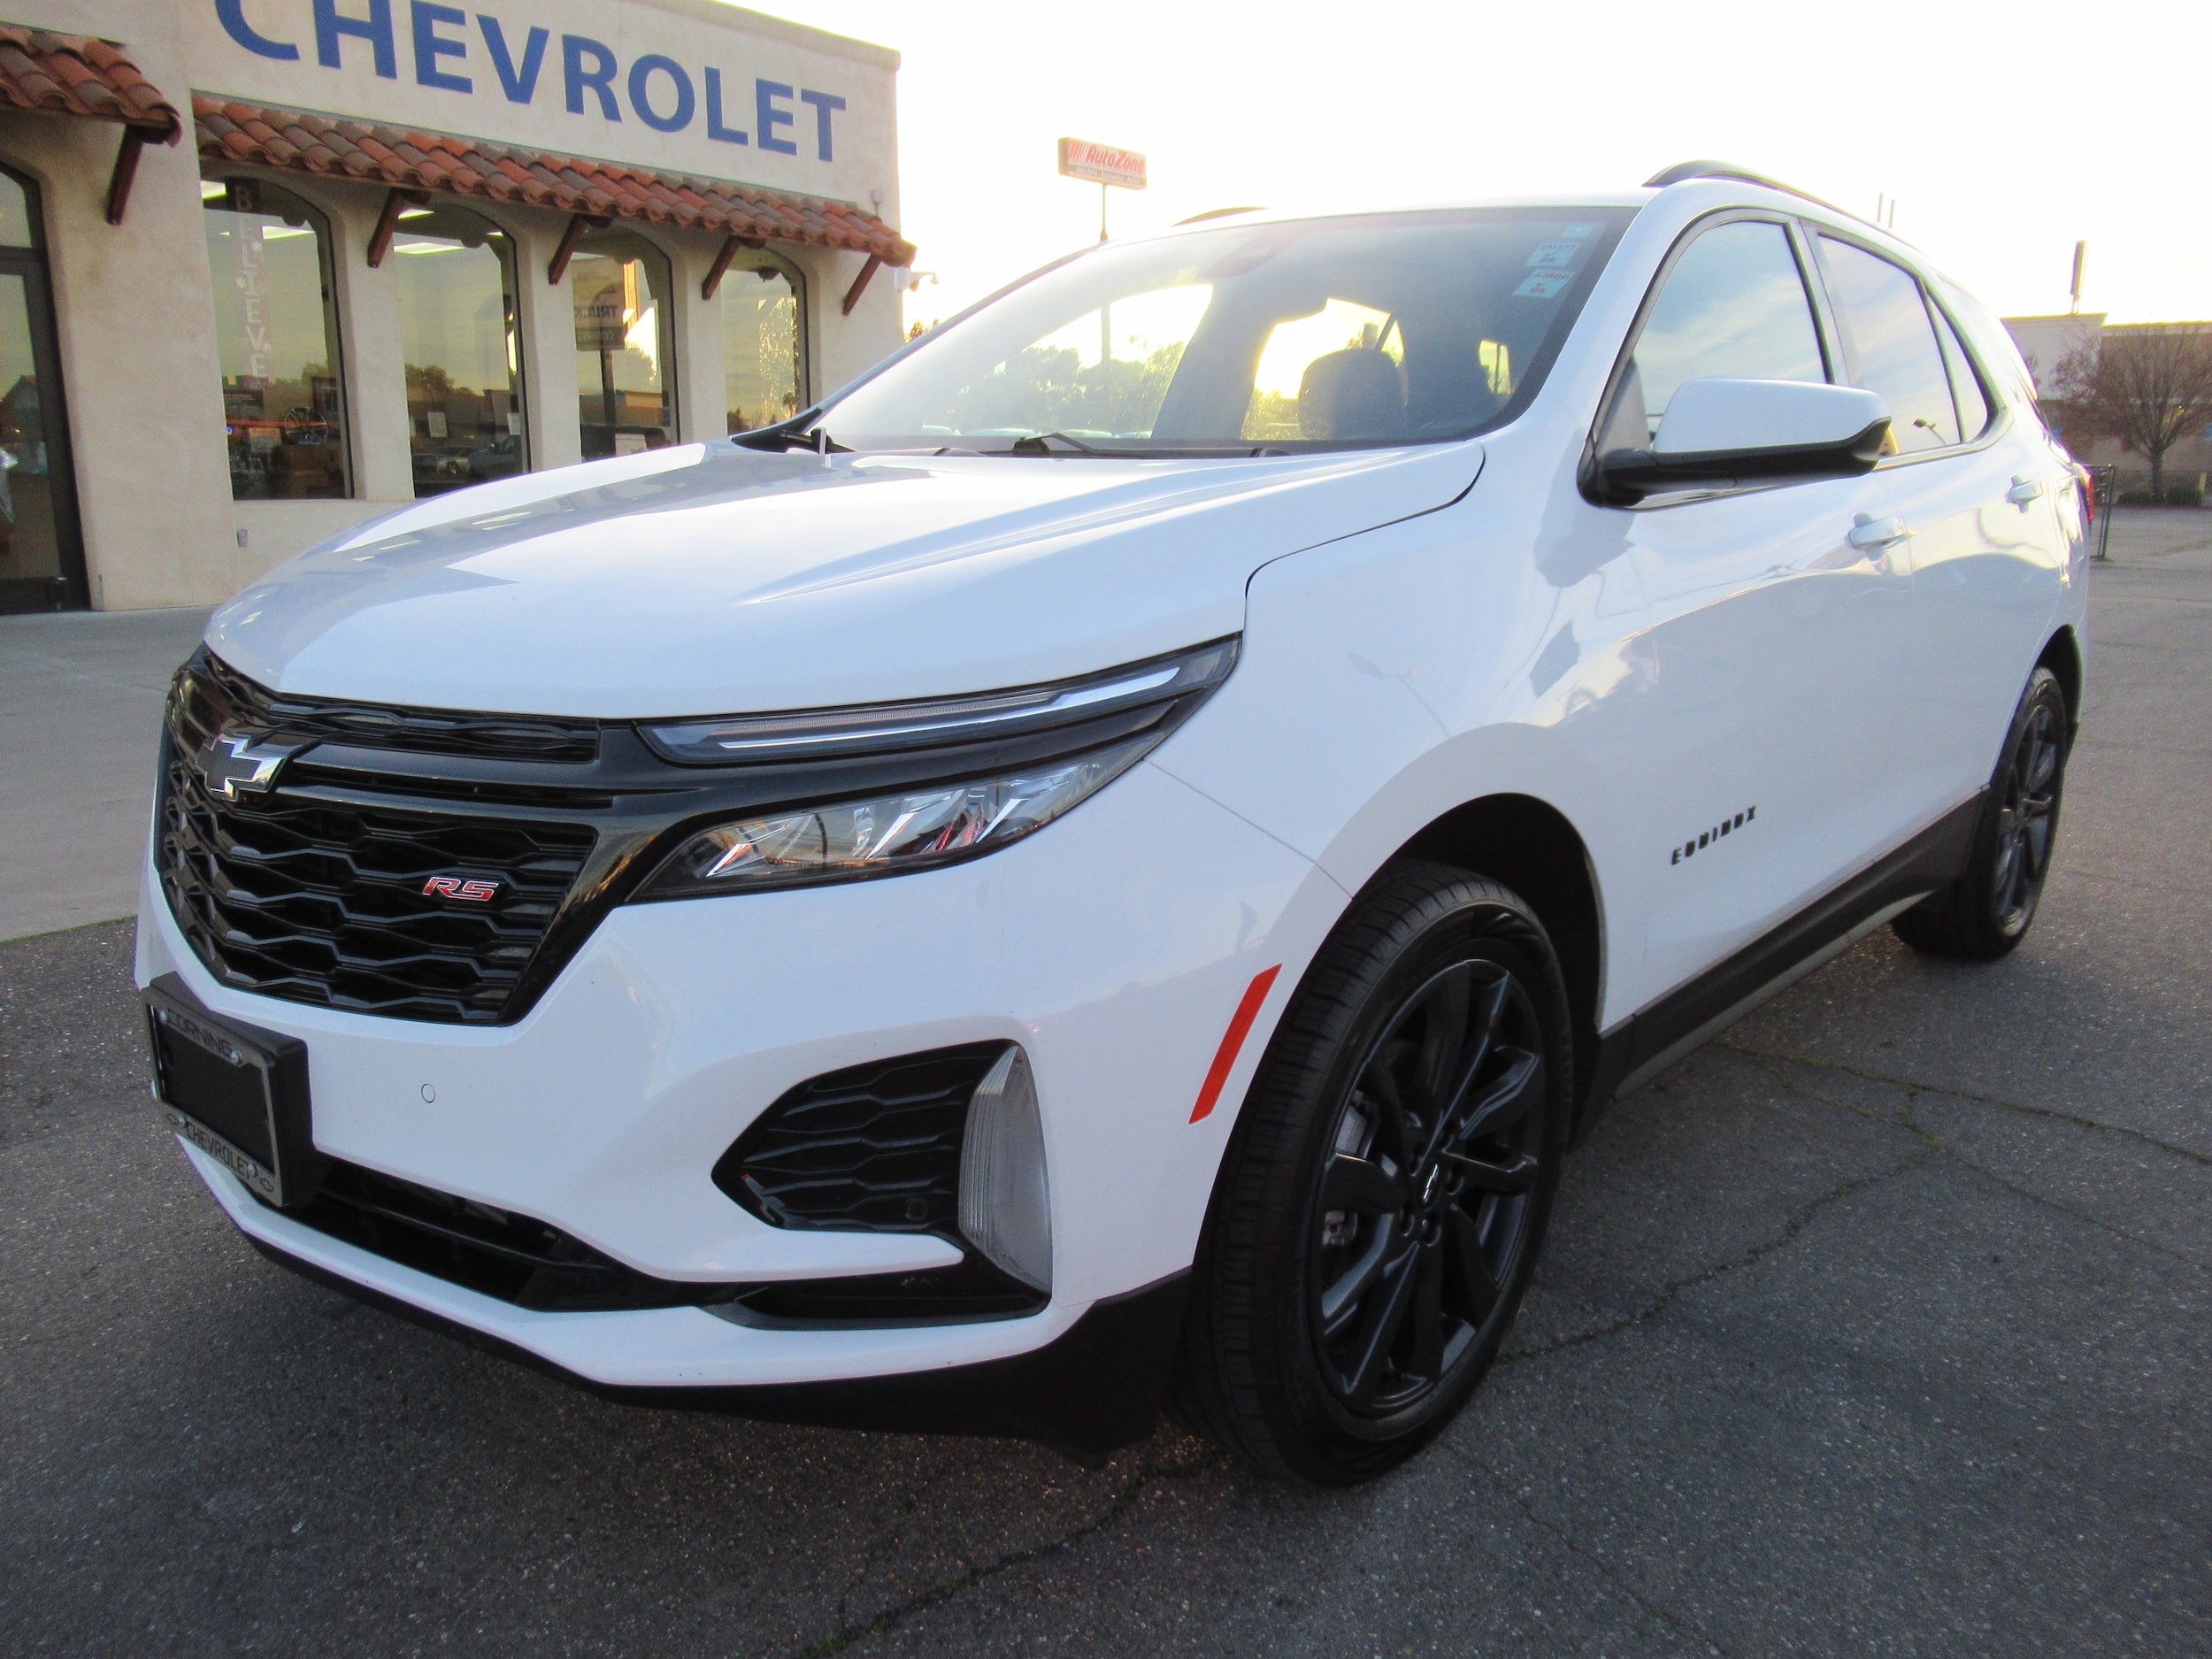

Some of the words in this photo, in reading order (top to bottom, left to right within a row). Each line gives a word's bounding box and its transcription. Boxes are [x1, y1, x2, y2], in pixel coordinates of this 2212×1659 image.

[214, 0, 846, 162] CHEVROLET
[1086, 144, 1145, 175] AutoZone
[234, 185, 265, 377] BELIEVE
[1671, 805, 1756, 865] EQUINOX
[423, 876, 499, 902] RS
